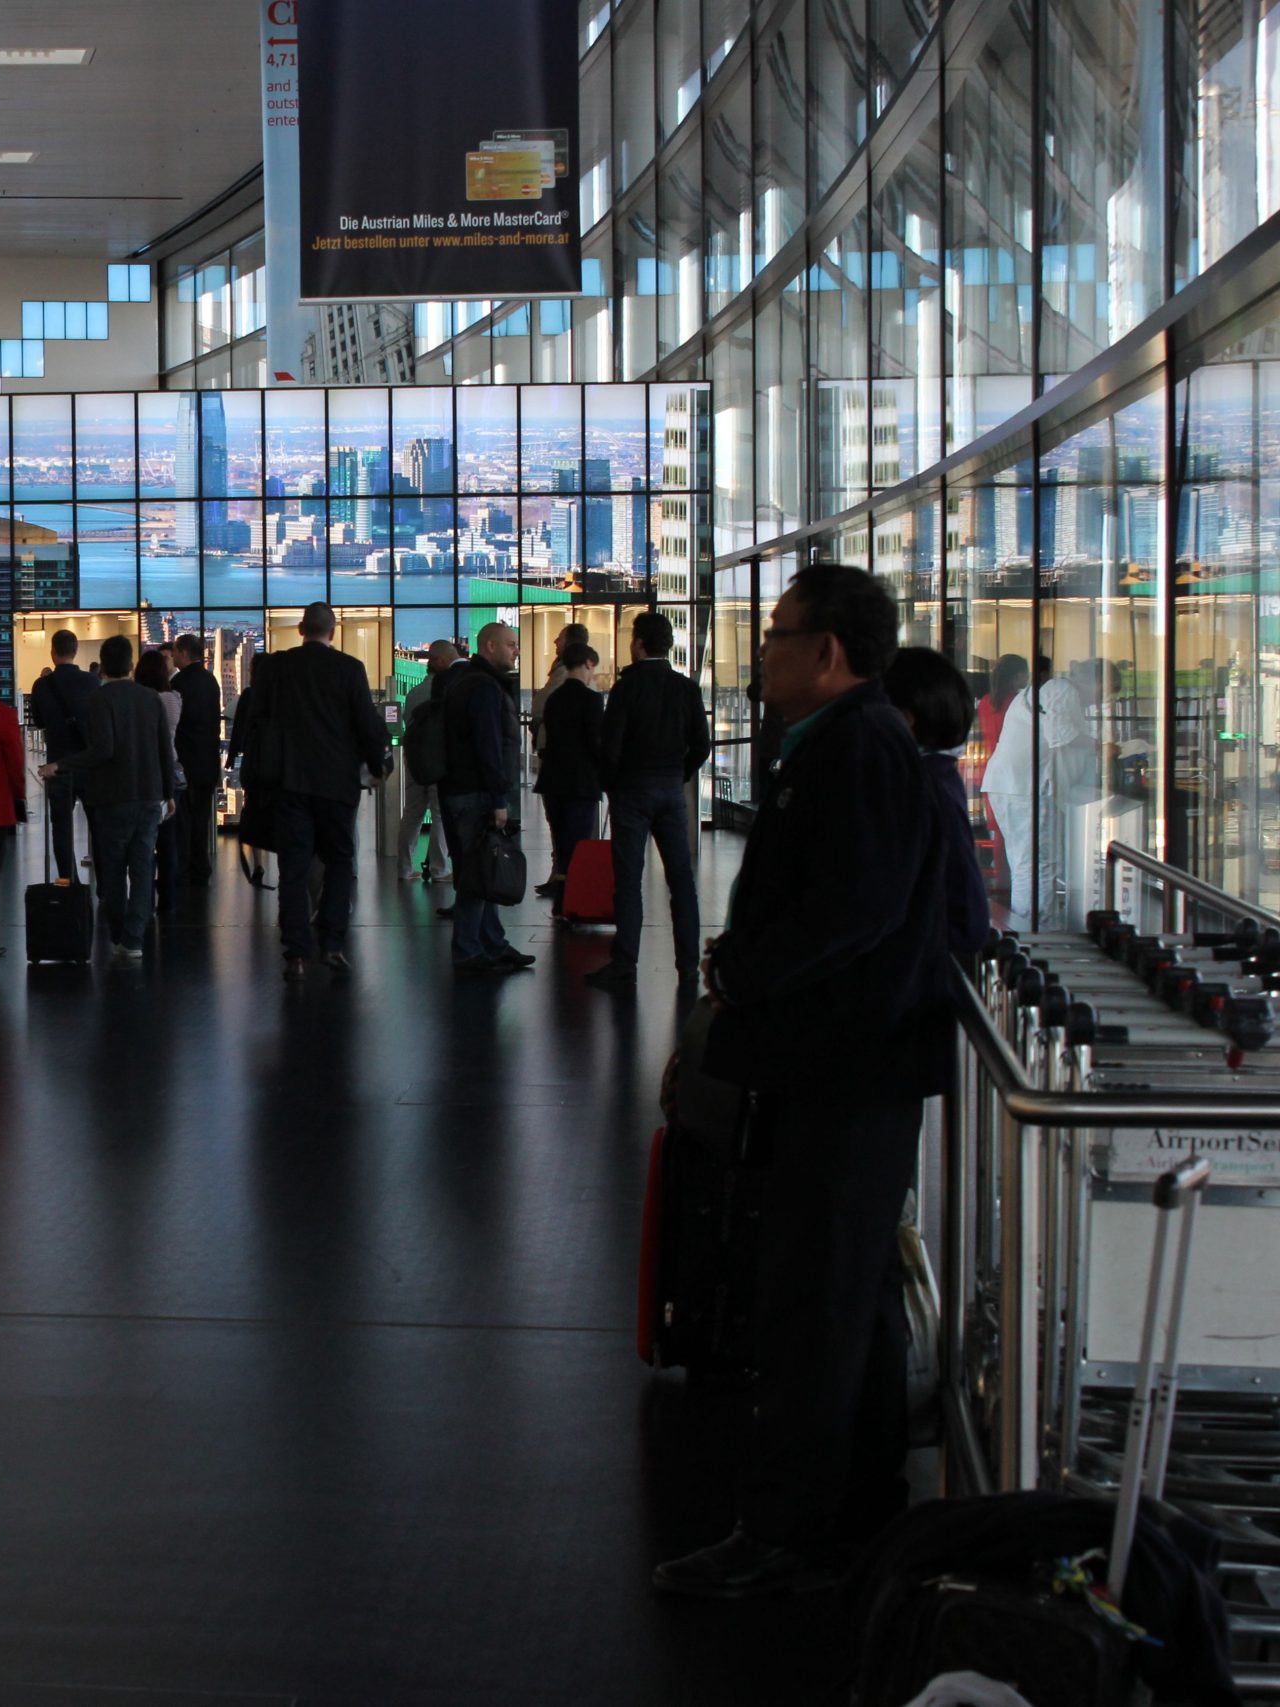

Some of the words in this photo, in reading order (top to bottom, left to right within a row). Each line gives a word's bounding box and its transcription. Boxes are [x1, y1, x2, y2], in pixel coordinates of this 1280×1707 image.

[266, 79, 291, 92] and
[340, 216, 359, 230] Die
[361, 215, 410, 230] Austrian
[413, 214, 444, 229] Miles
[447, 213, 458, 228] &
[460, 213, 491, 227] More
[312, 236, 341, 250] Jetzt
[344, 235, 396, 249] bestellen
[399, 234, 430, 248] unter
[432, 232, 569, 247] www.miles-and-more.at
